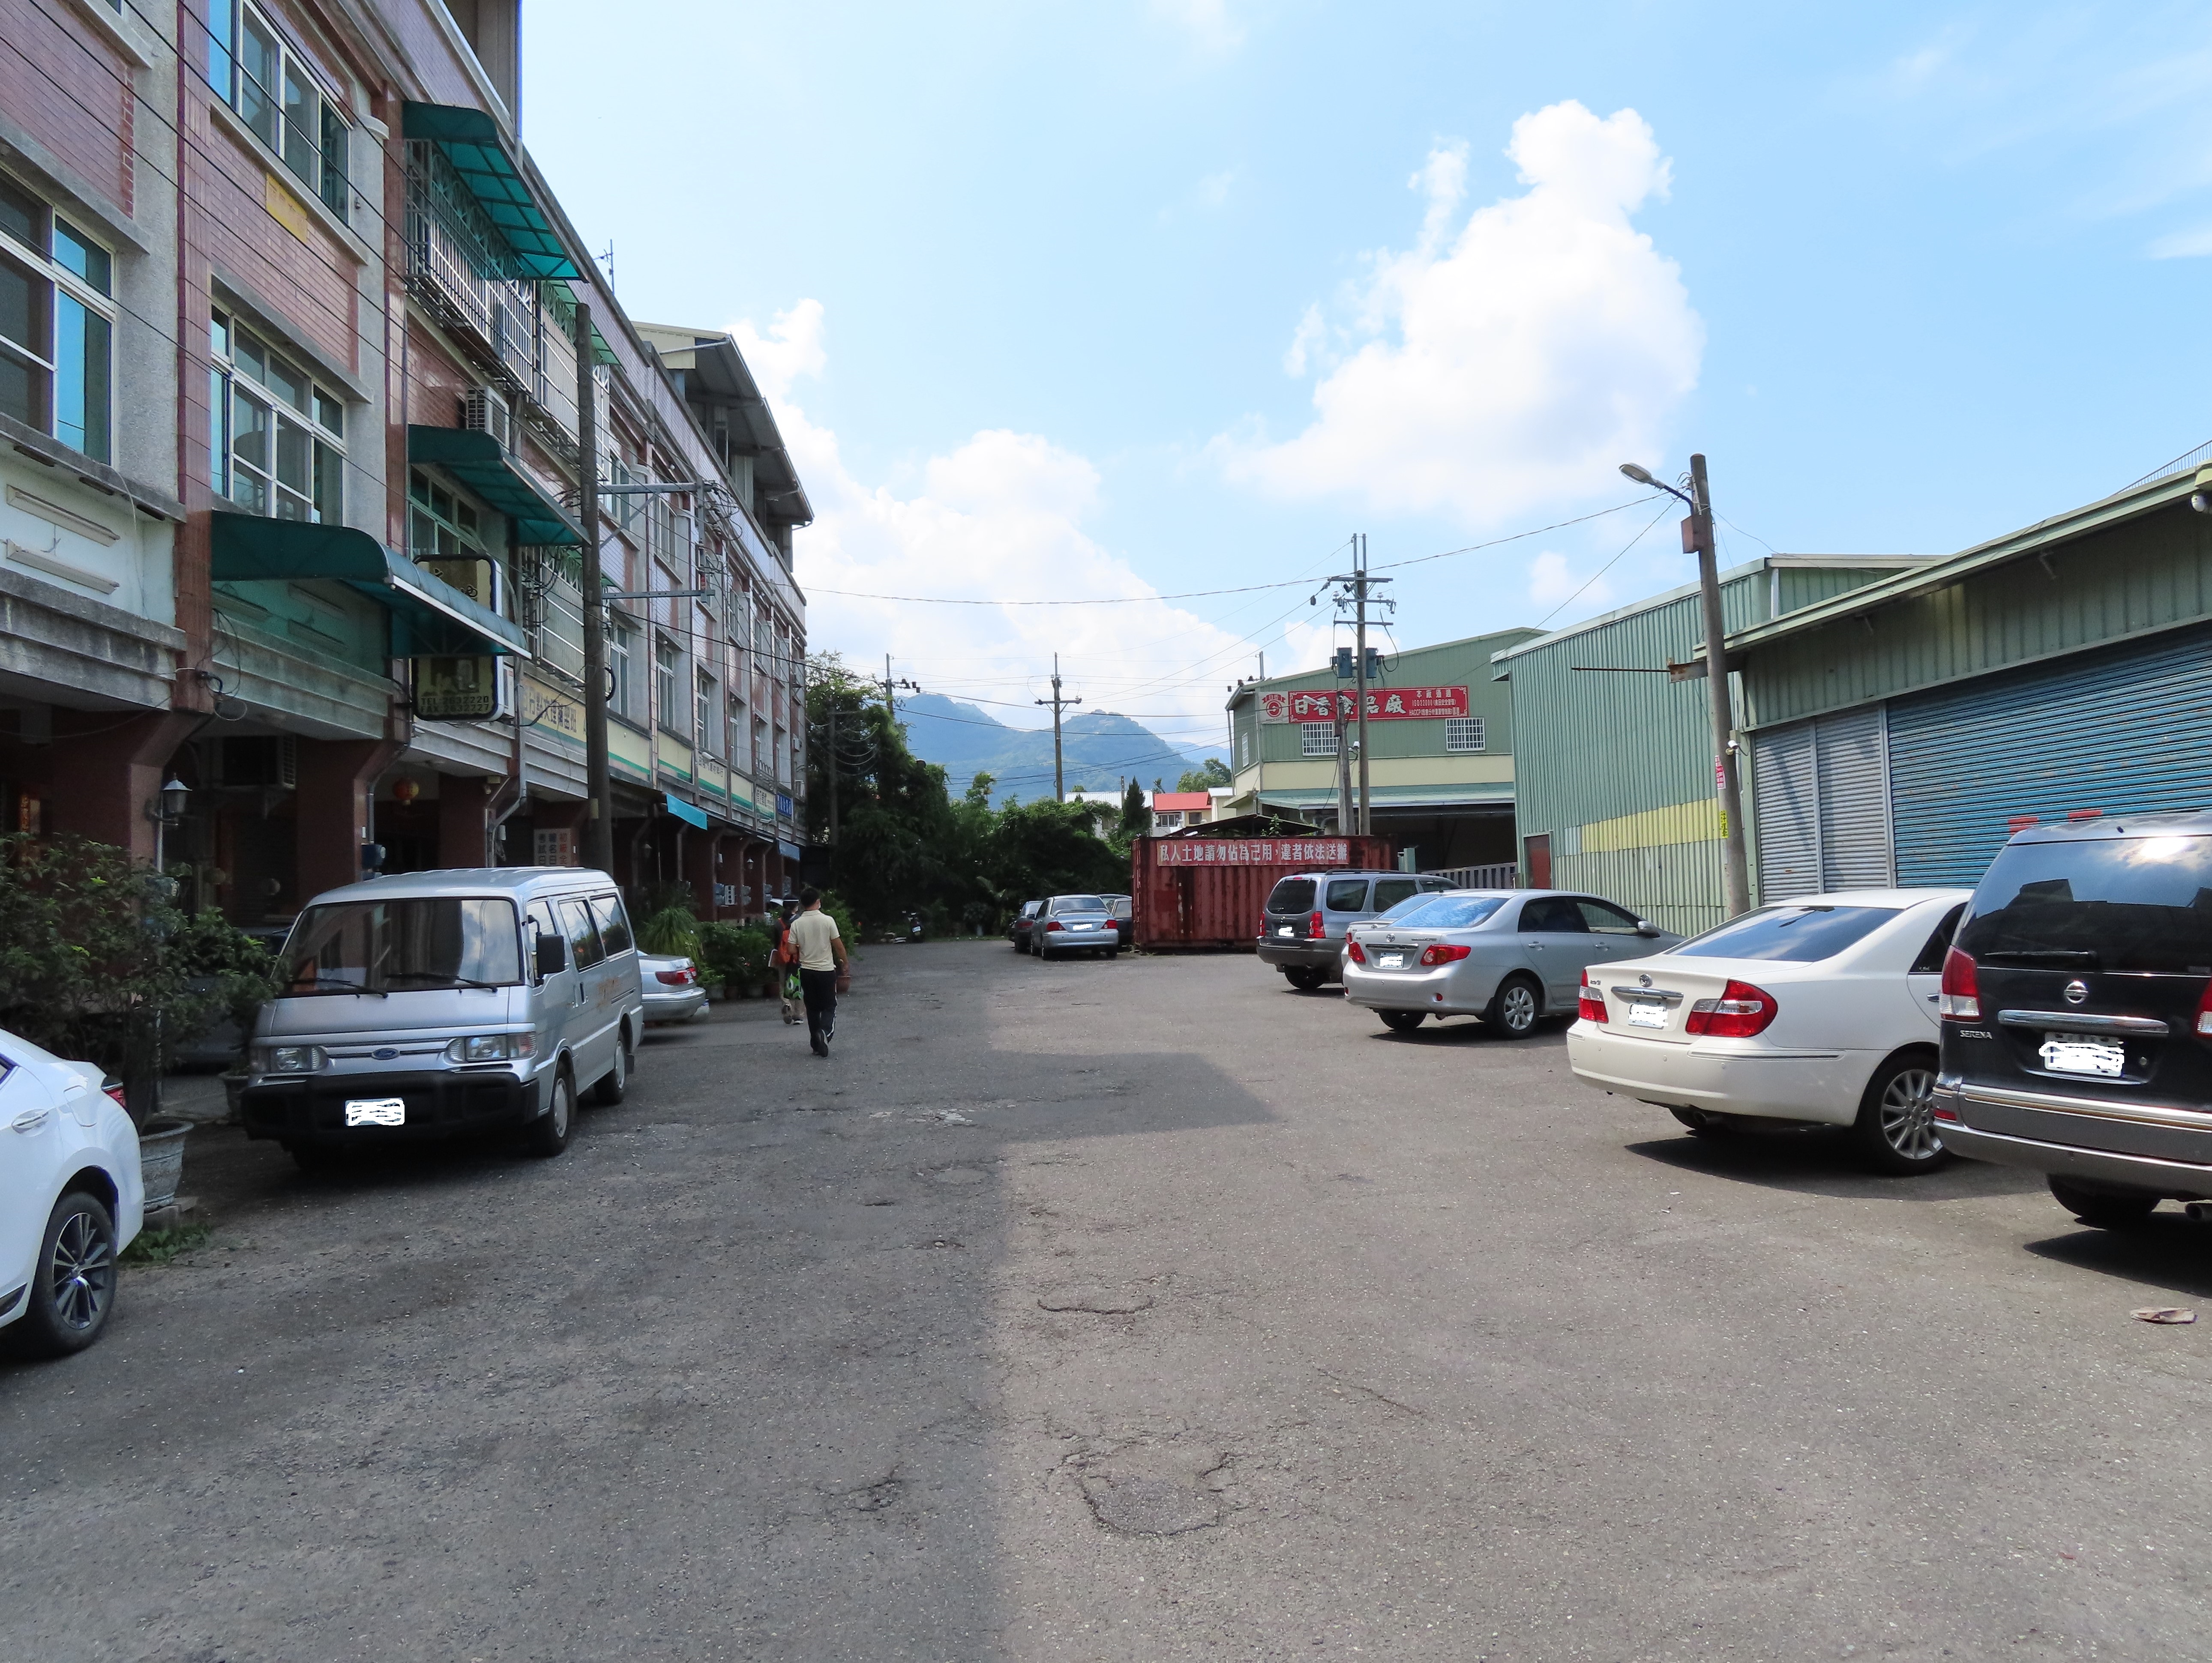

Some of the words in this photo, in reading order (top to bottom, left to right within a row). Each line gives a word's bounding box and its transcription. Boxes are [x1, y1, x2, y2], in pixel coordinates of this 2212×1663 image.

[1160, 843, 1348, 861] 私人土地請勿佔為己用，違者依法送辦
[1960, 1030, 1993, 1040] SERENA
